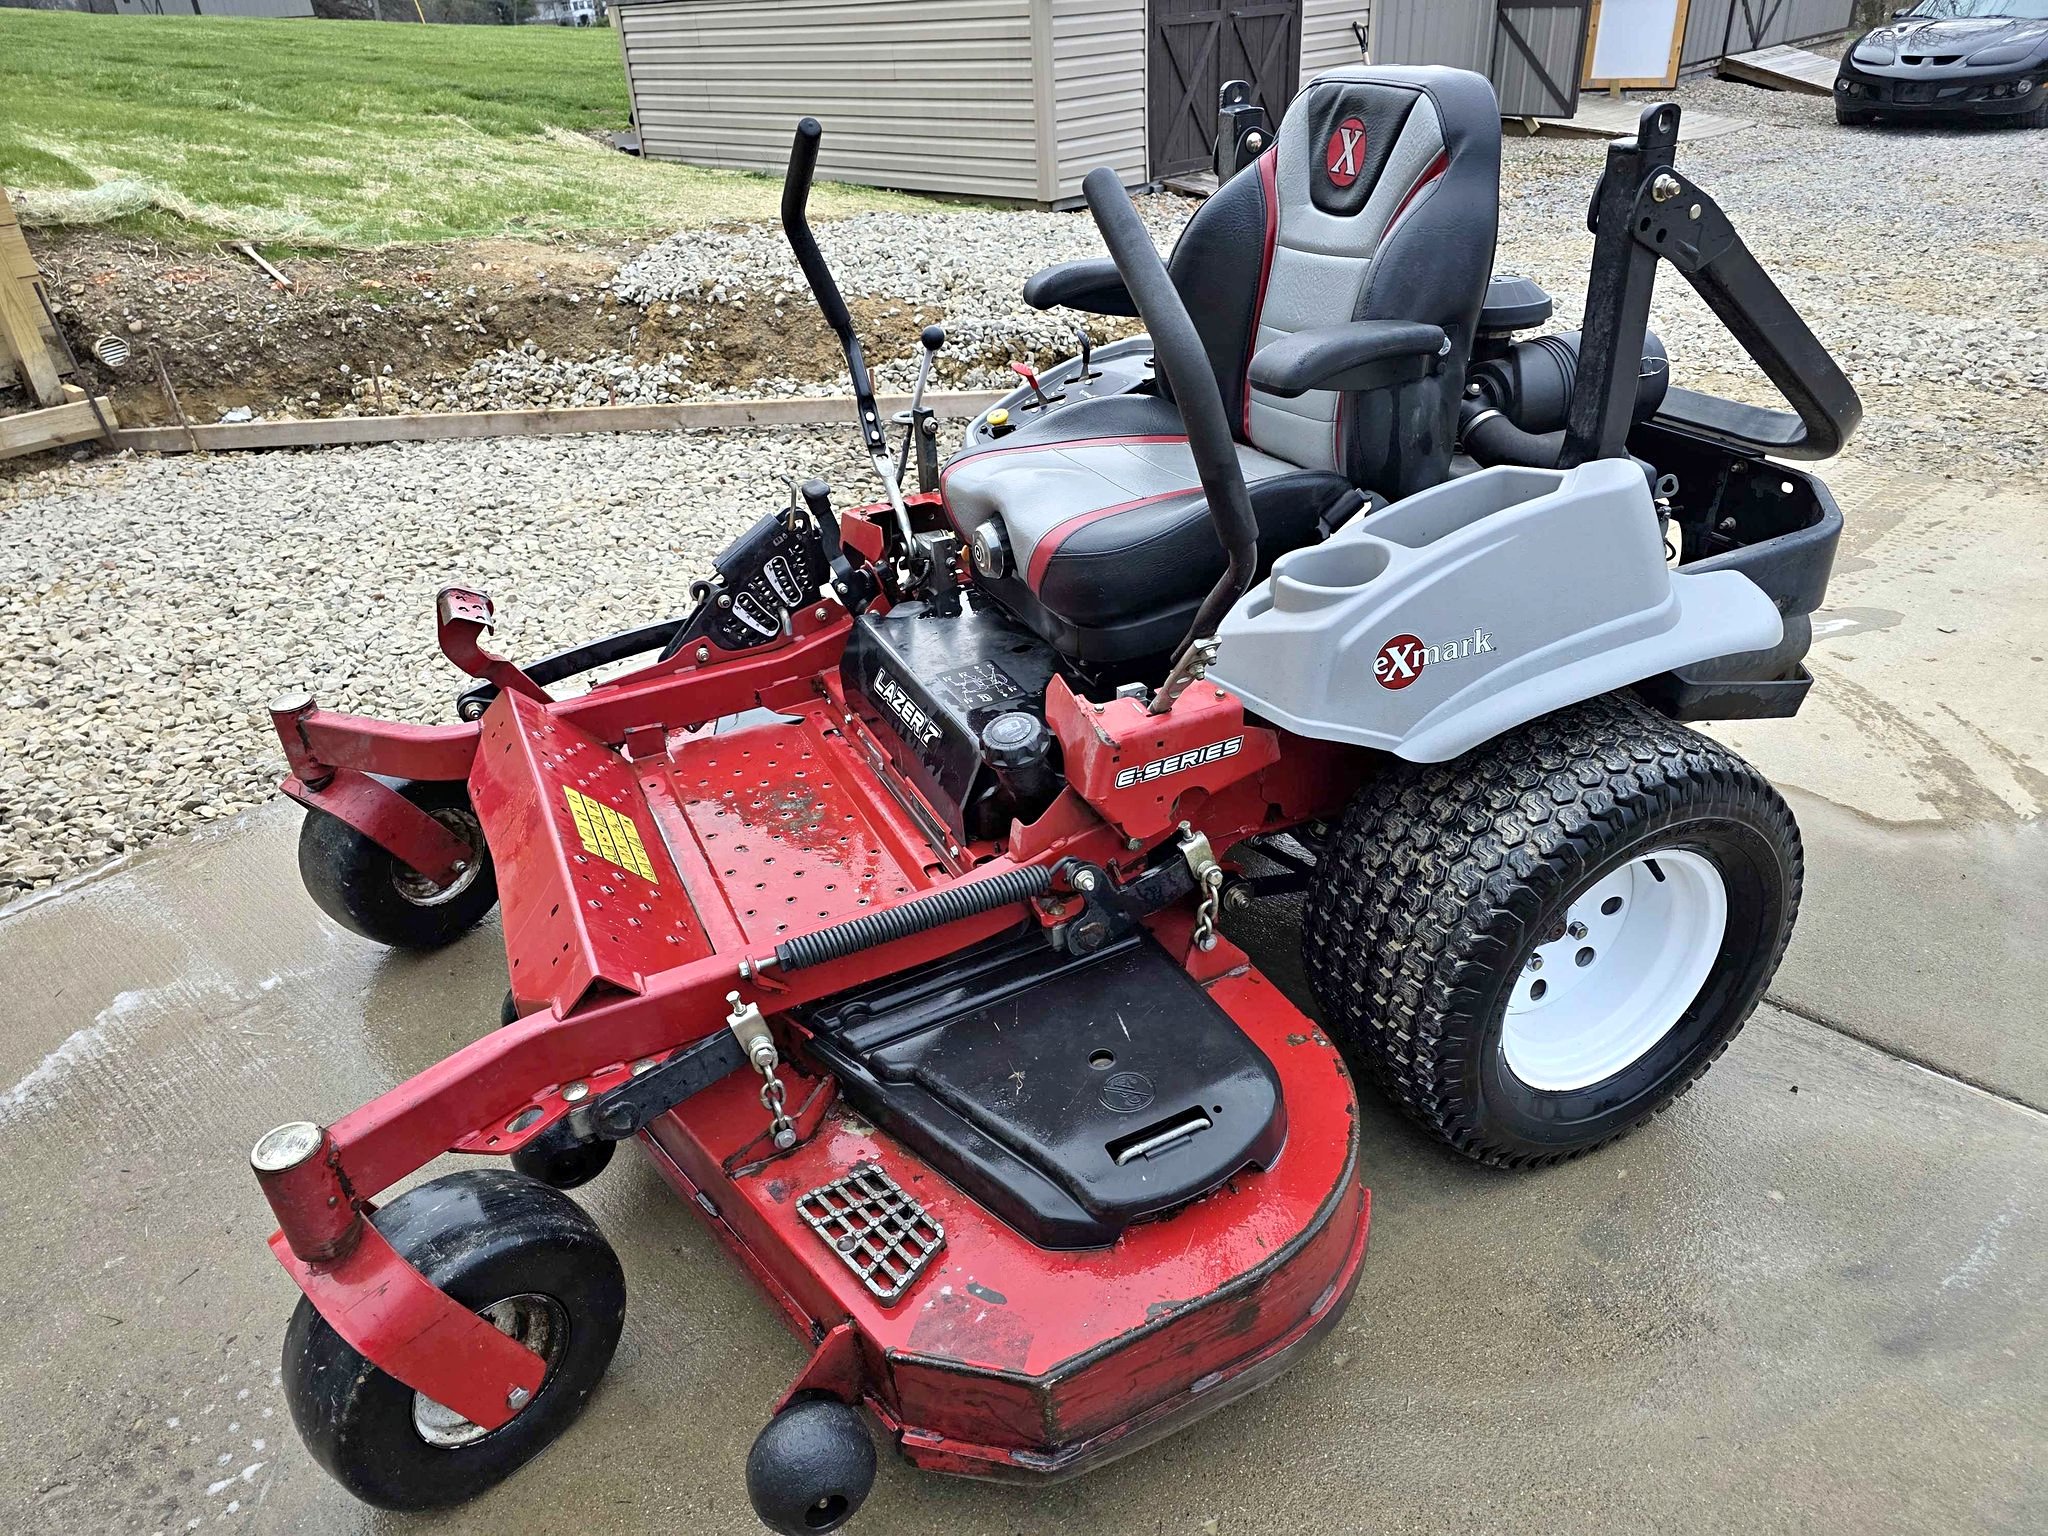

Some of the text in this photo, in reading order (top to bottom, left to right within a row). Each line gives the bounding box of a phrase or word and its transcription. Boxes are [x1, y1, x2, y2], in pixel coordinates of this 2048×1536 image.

[1330, 127, 1363, 176] X
[873, 667, 926, 739] LAZER
[1116, 736, 1243, 788] E-SERIES
